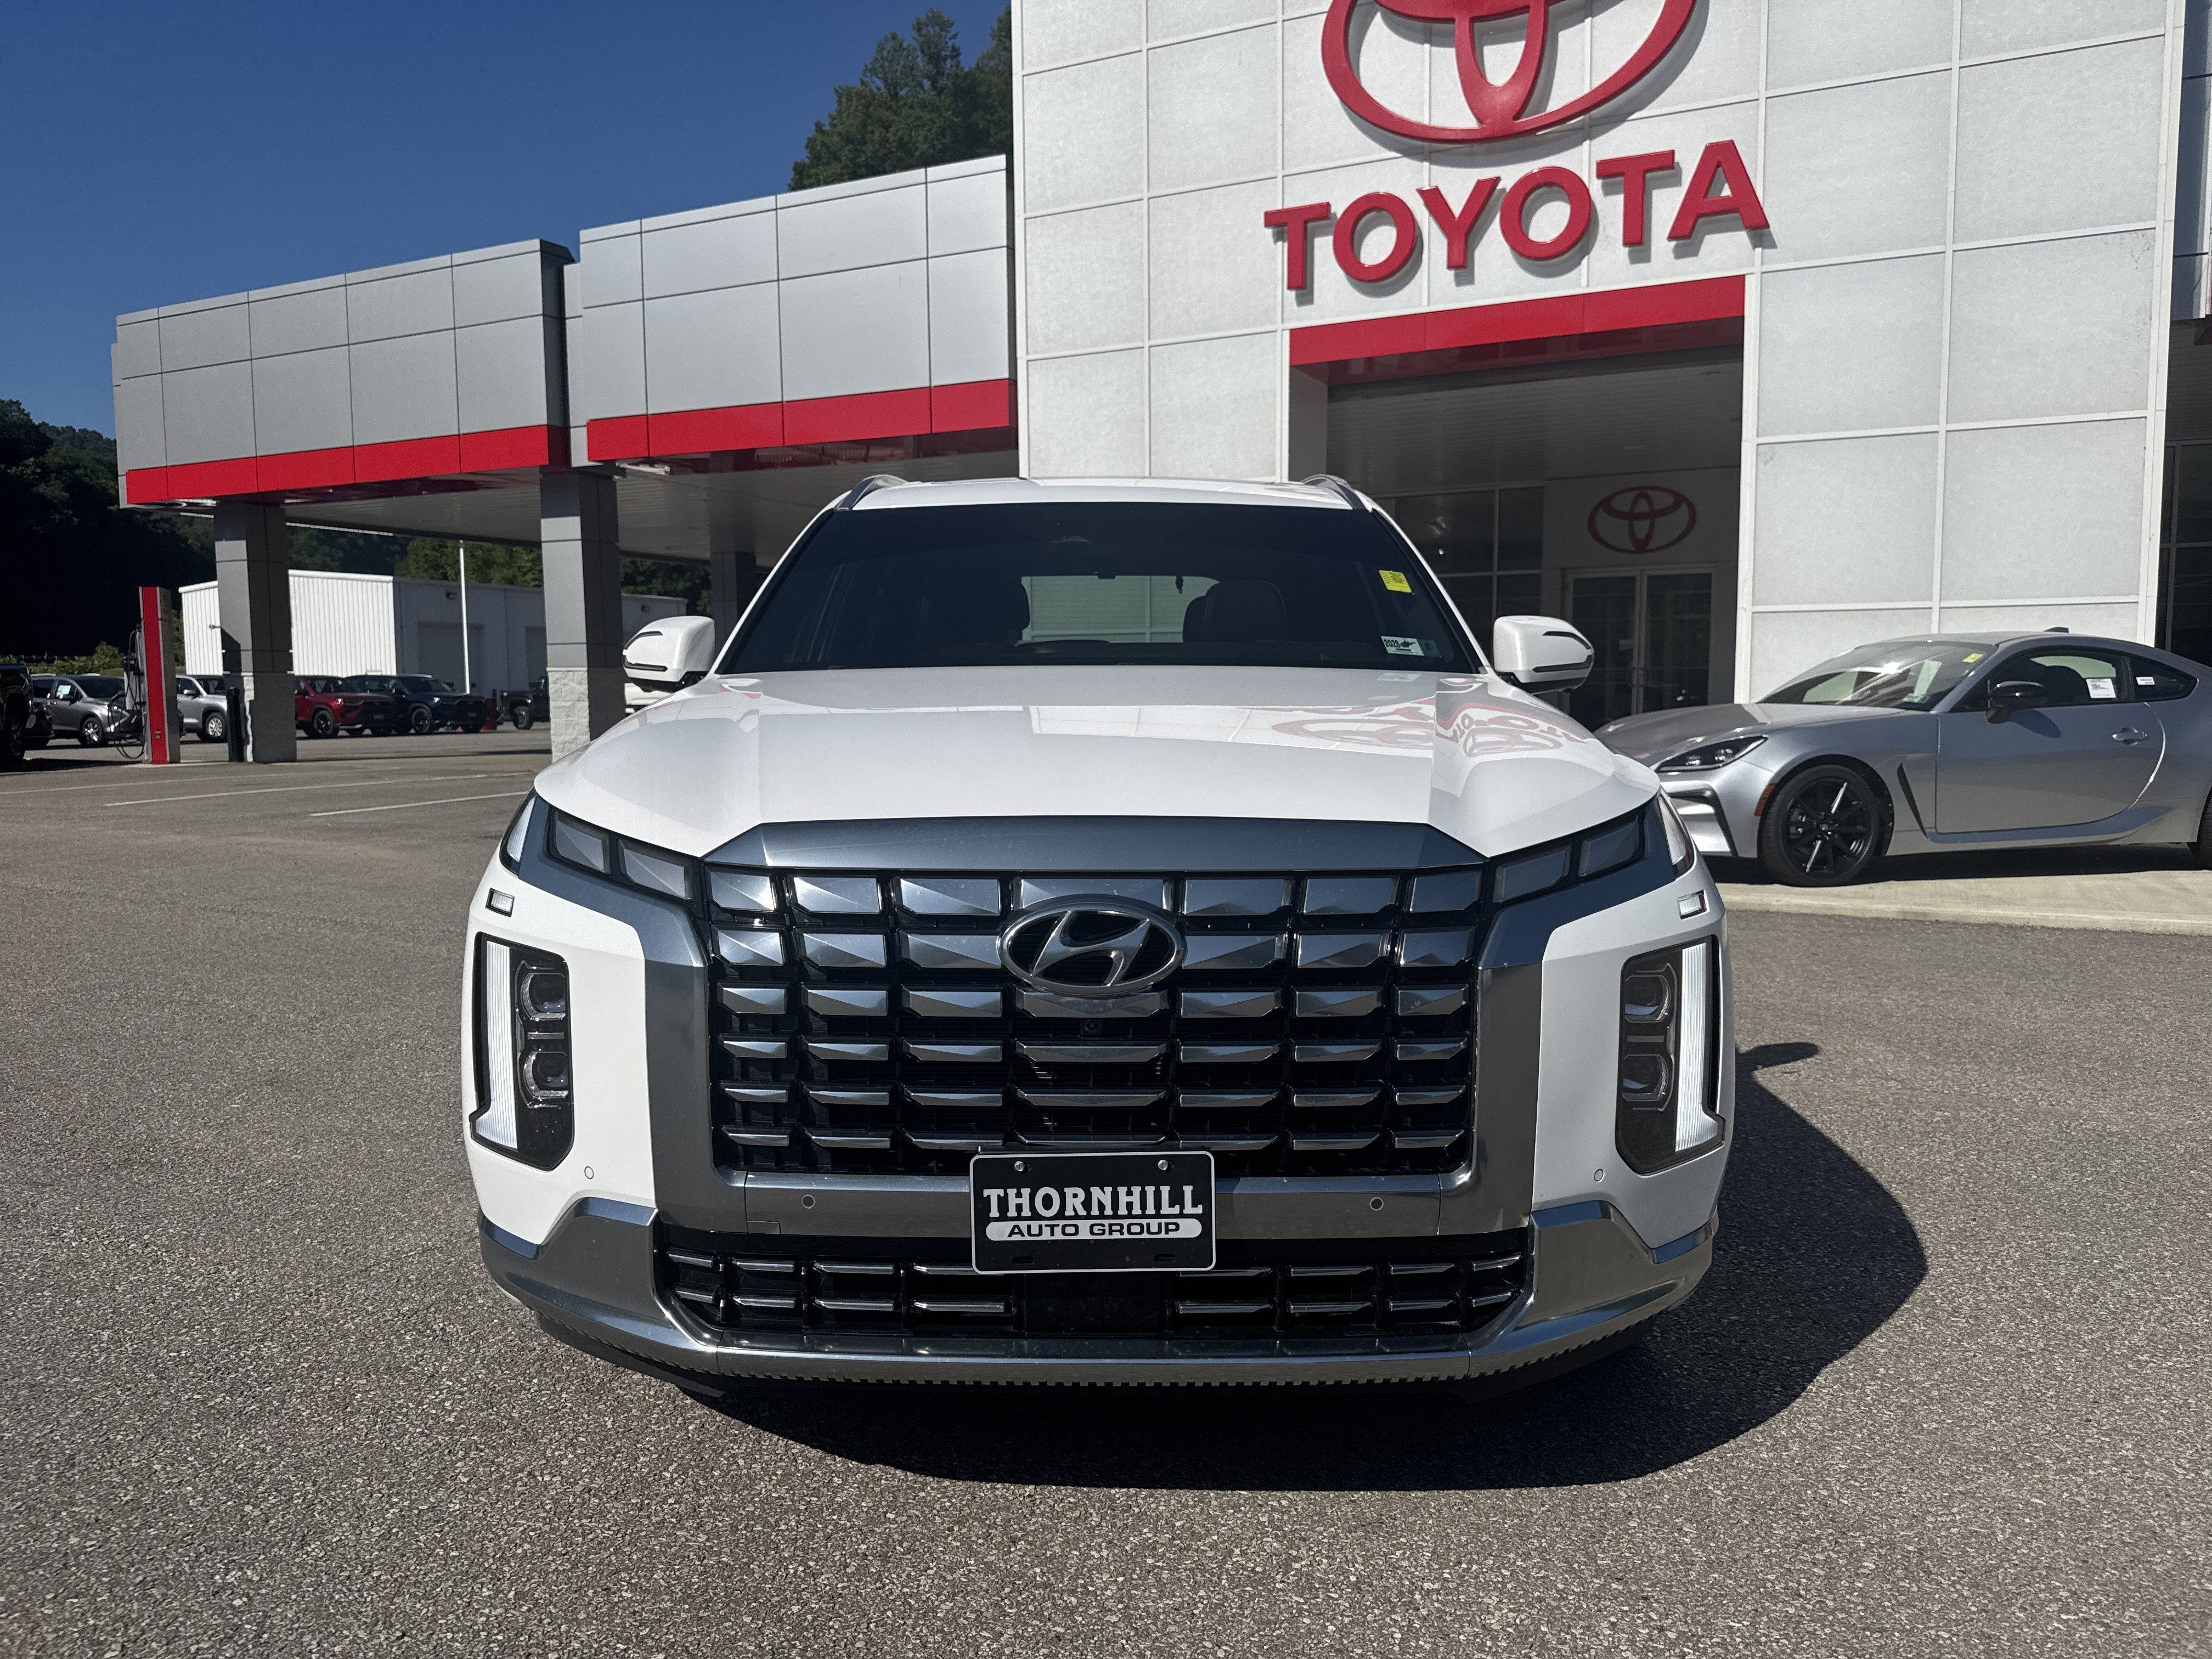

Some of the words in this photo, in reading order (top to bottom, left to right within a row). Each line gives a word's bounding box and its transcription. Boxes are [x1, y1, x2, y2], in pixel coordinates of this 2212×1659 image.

[1264, 139, 1770, 290] TOYOTA
[983, 1185, 1203, 1217] THORNHILL
[1007, 1223, 1079, 1238] AUTO
[1089, 1222, 1181, 1237] GROUP
